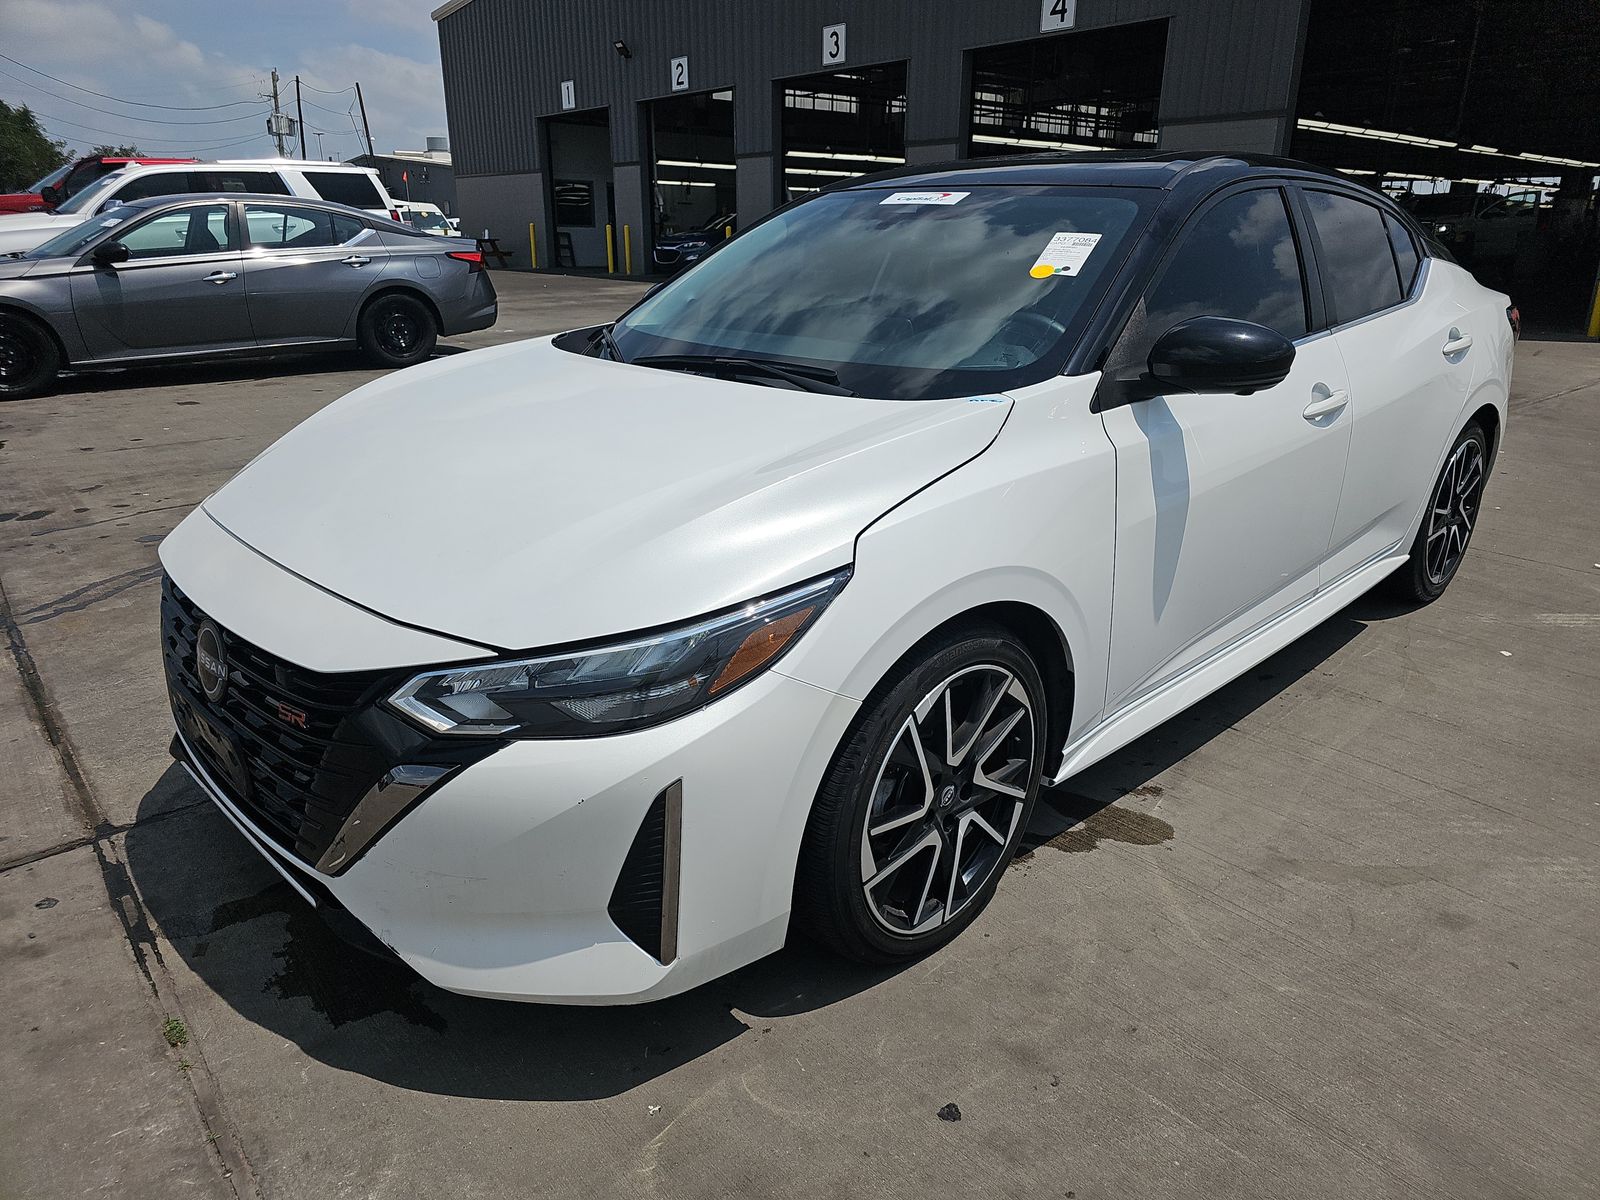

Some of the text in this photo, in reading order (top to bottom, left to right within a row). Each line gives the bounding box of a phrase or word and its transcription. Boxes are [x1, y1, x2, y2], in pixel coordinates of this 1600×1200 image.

[1050, 0, 1067, 22] 4
[829, 31, 839, 58] 3
[675, 63, 684, 85] 2
[566, 86, 571, 105] 1
[200, 651, 226, 678] SSAN
[278, 703, 306, 728] SR
